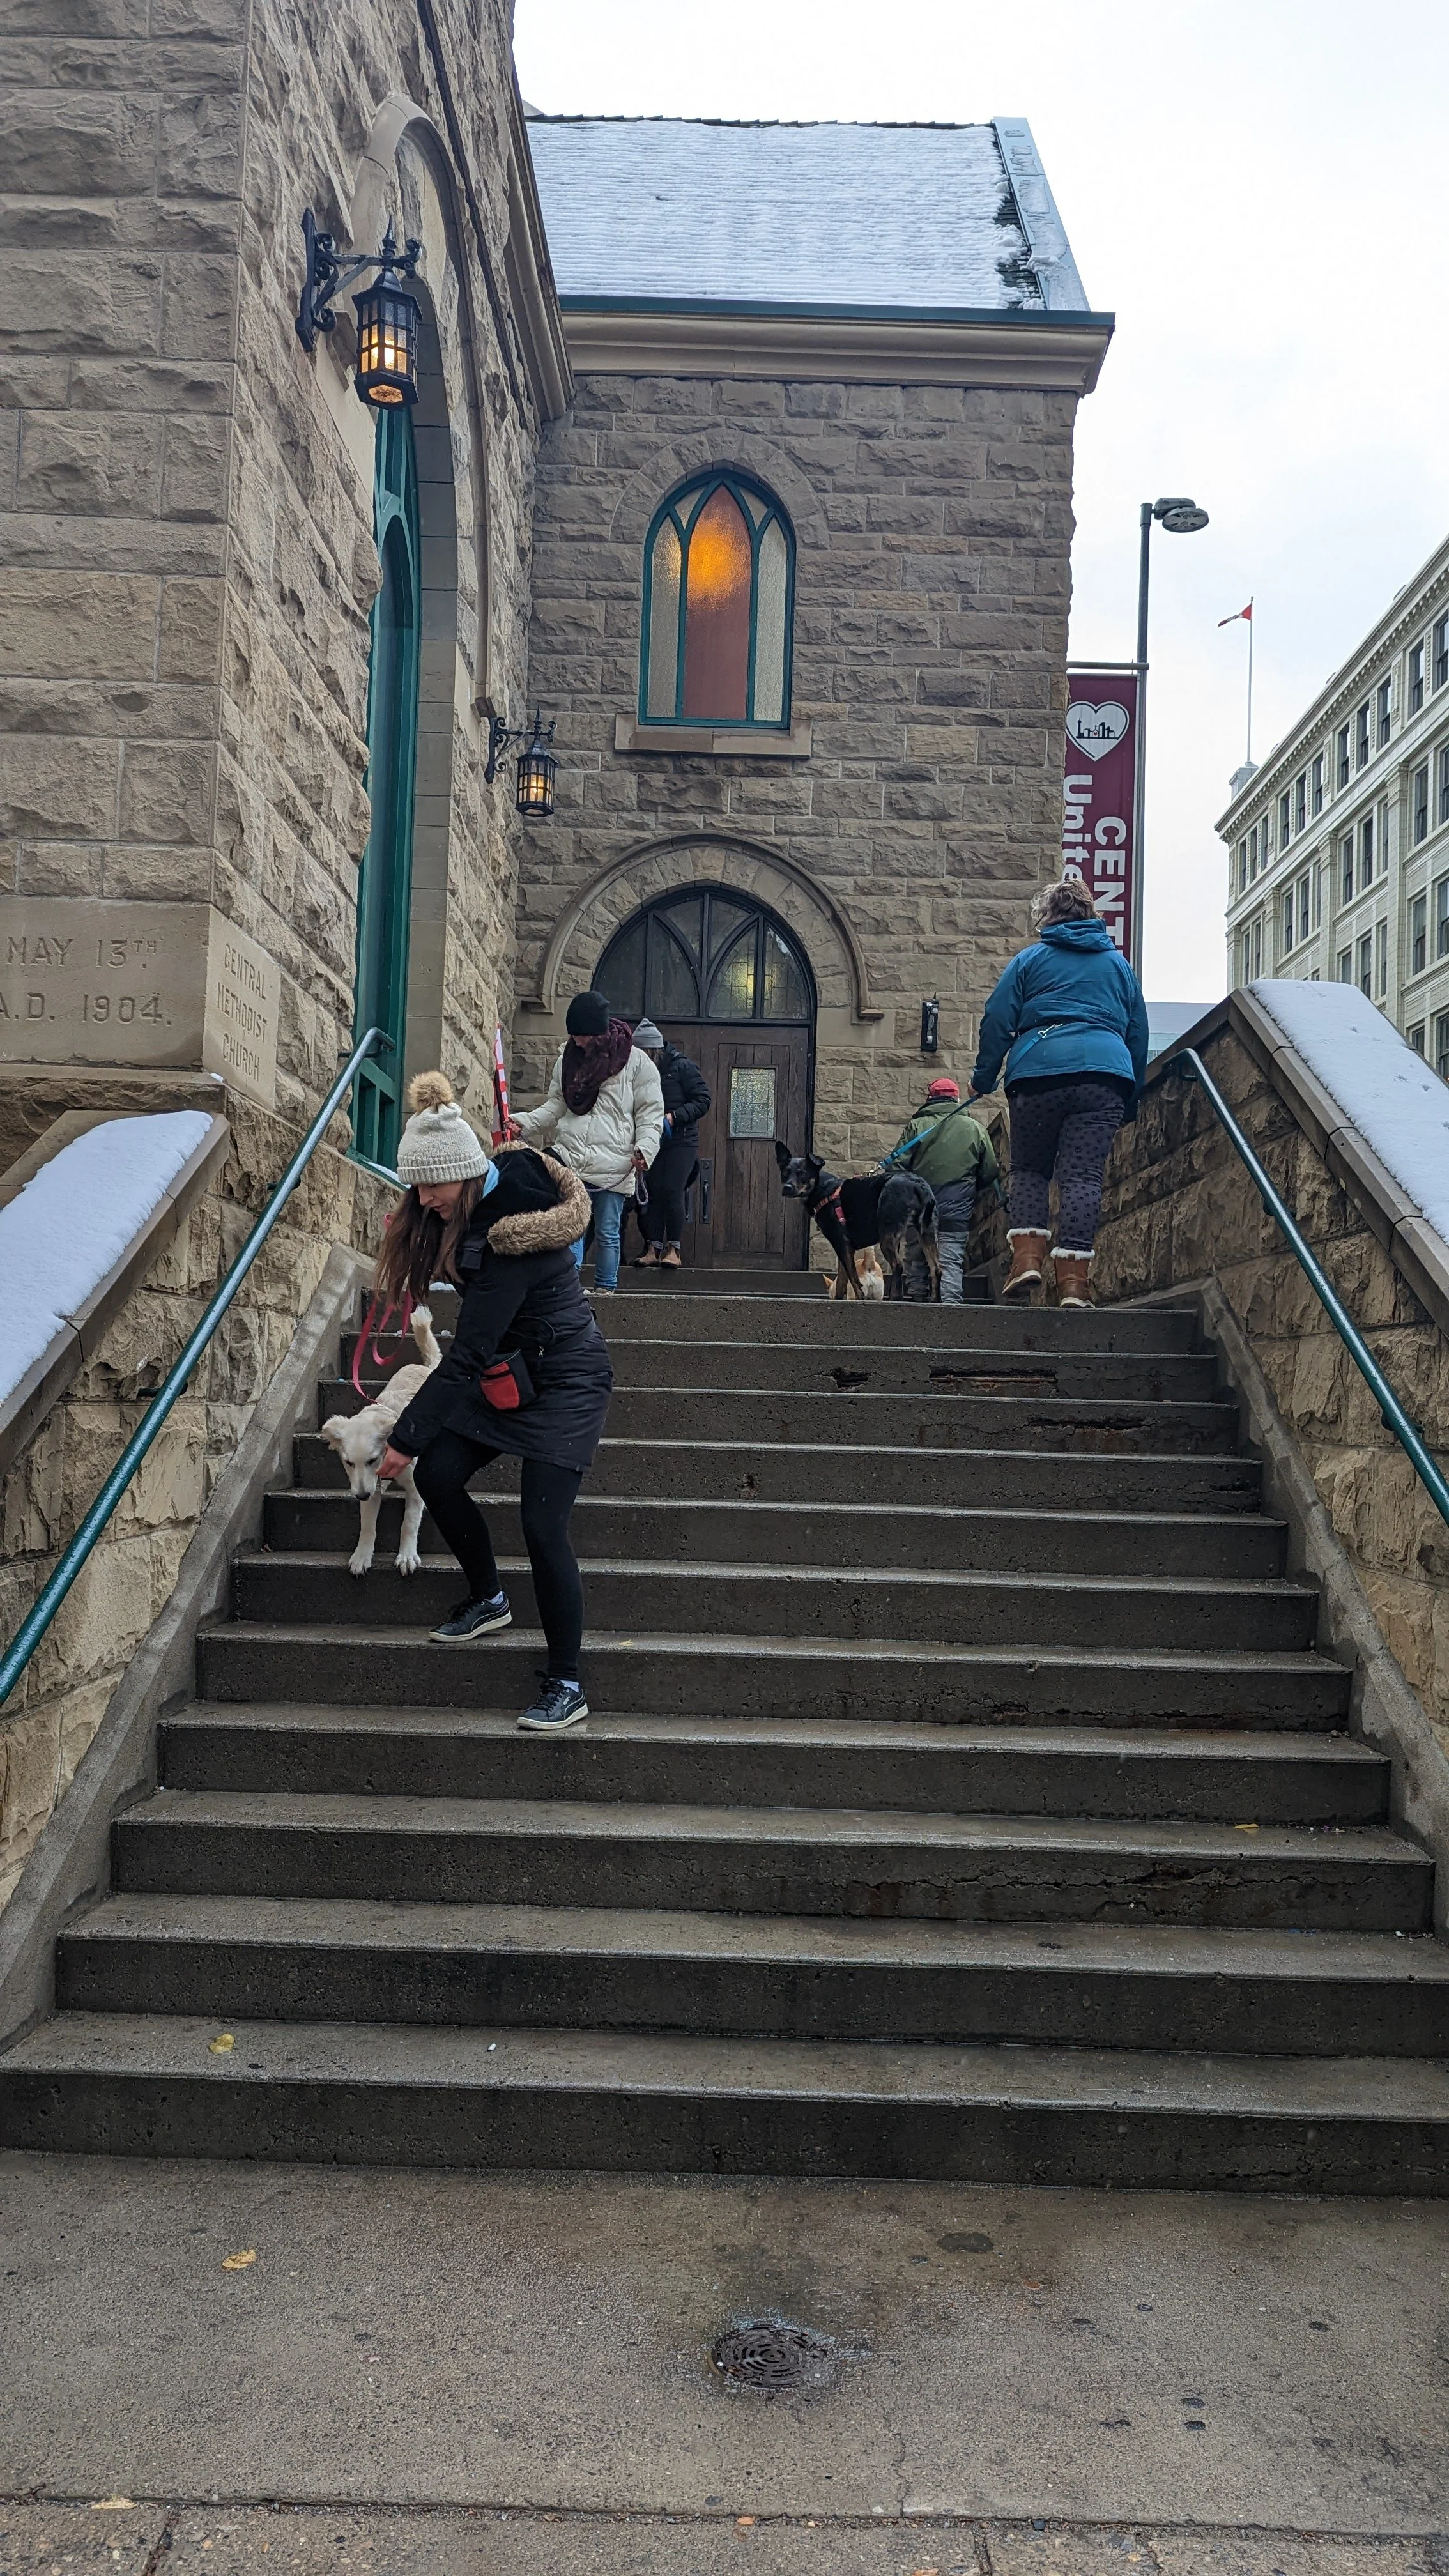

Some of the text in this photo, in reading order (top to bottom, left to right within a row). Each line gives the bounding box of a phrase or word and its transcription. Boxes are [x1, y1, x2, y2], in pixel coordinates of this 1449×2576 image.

[1093, 816, 1126, 956] CENT
[6, 936, 74, 967] MAY
[224, 942, 266, 1000] CENTRAL
[82, 993, 172, 1027] 1904.
[217, 981, 268, 1043] METHODIST
[222, 1032, 260, 1082] CHURCH
